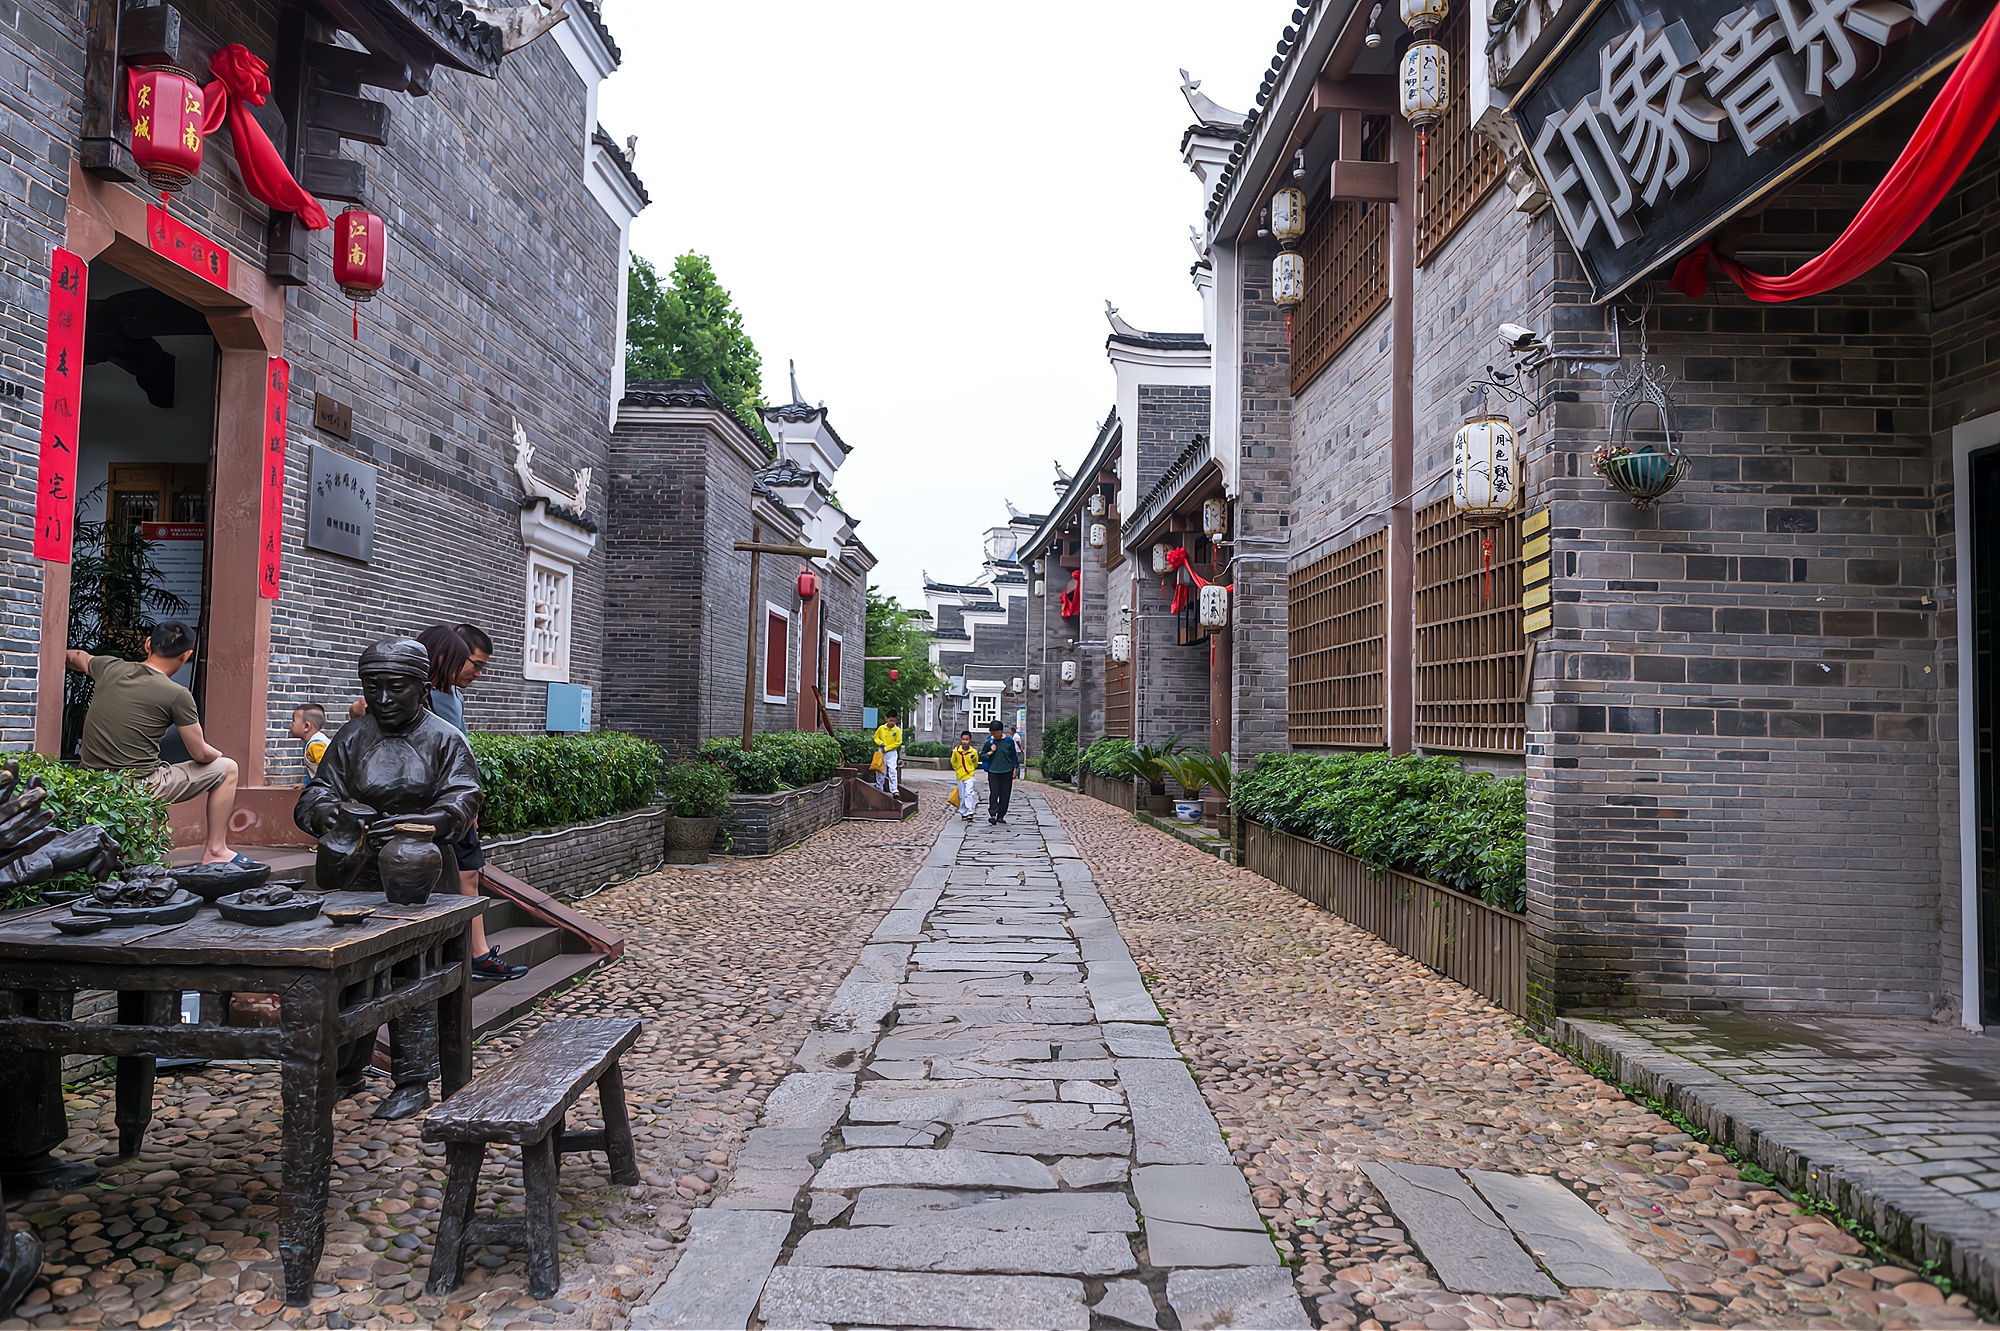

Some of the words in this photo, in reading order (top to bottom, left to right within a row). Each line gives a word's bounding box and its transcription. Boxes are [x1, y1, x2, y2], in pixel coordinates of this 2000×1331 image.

[134, 84, 152, 141] 宋城
[182, 91, 202, 153] 江南
[1533, 0, 1952, 250] 印象音乐
[348, 219, 367, 266] 江南
[1493, 434, 1512, 493] 月色印象
